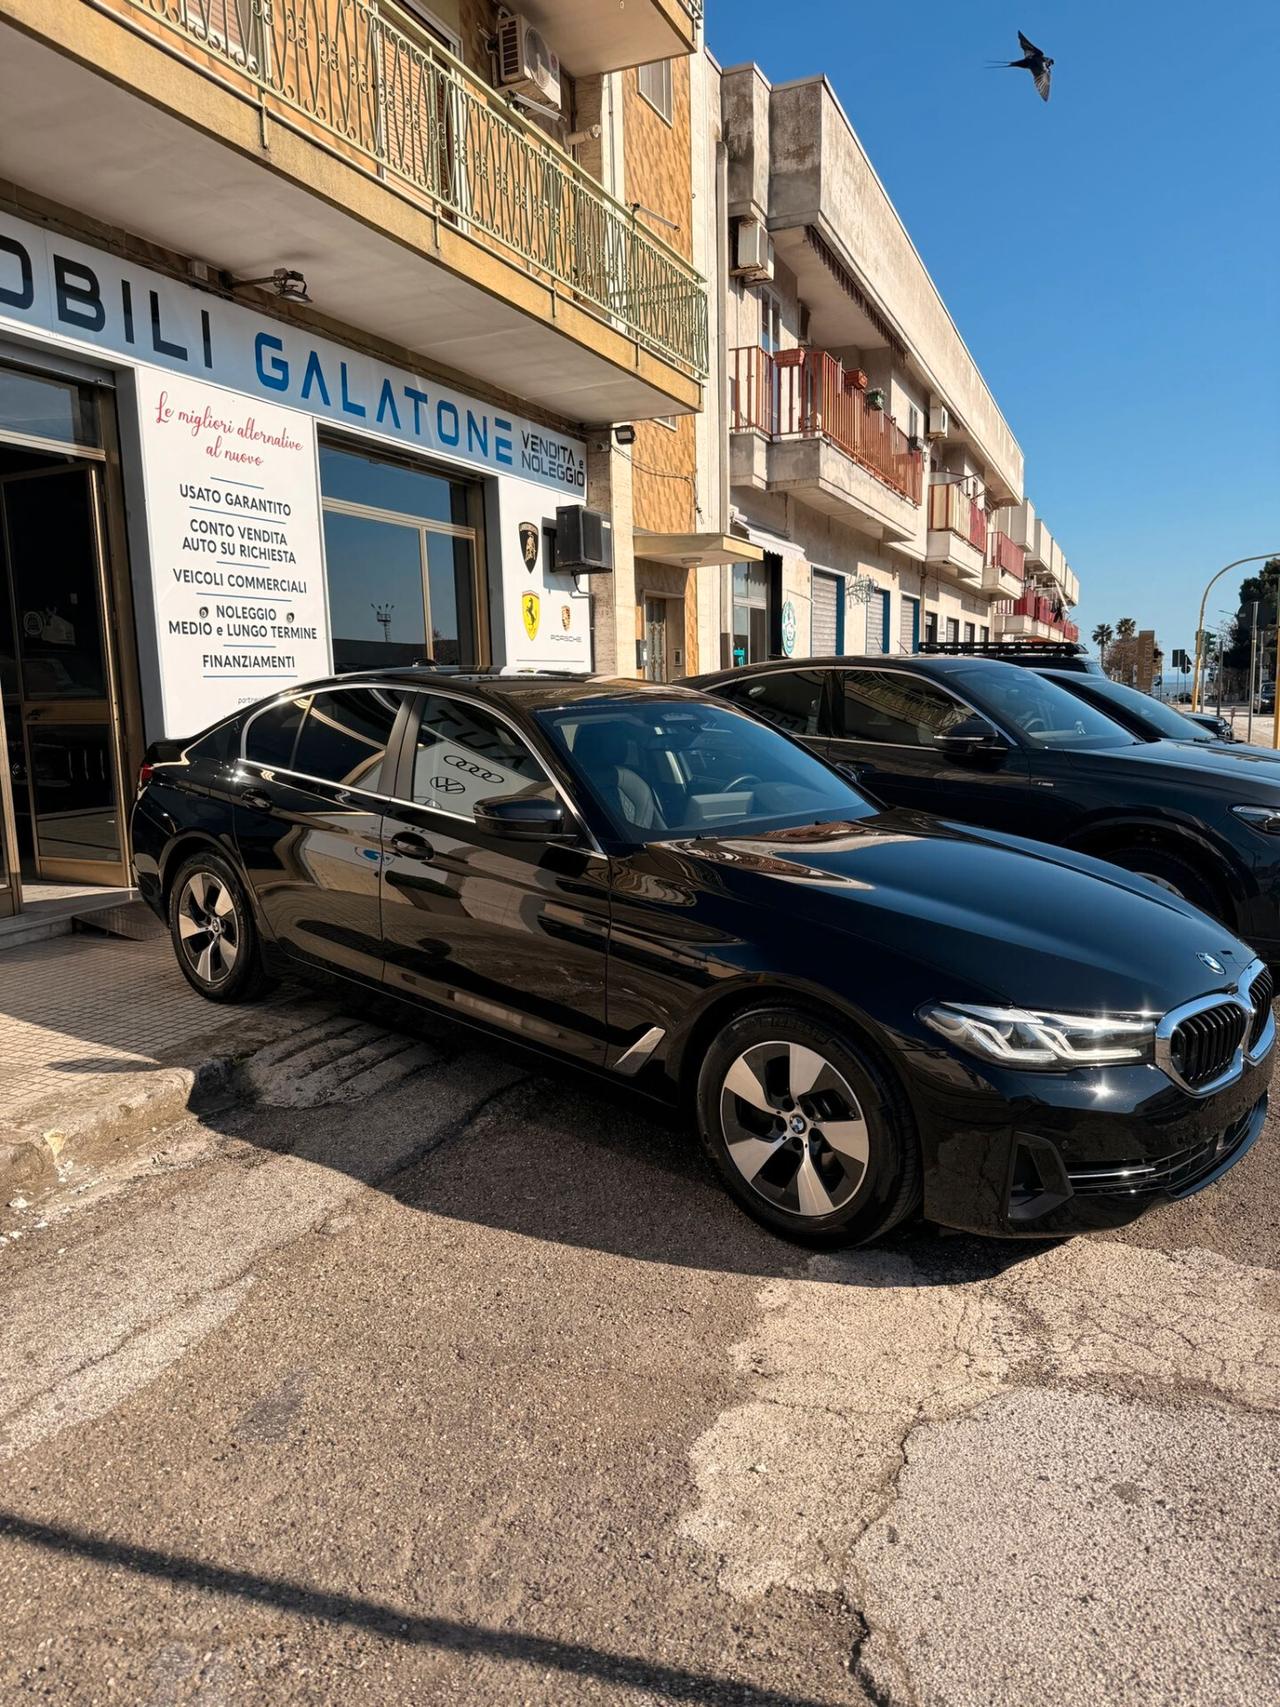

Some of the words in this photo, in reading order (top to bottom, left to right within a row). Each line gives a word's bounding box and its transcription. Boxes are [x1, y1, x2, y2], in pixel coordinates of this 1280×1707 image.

[254, 331, 513, 466] GALATONE
[154, 391, 175, 424] Le
[178, 405, 235, 436] migliori
[237, 416, 304, 451] alternative
[205, 435, 222, 458] al
[224, 448, 265, 466] nuovo
[521, 430, 575, 467] VENDITA
[578, 459, 584, 469] e
[521, 451, 585, 487] NOLEGGIO
[180, 483, 221, 504] USATO
[225, 492, 291, 516] GARANTITO
[190, 518, 235, 538] CONTO
[237, 526, 288, 546] VENDITA
[182, 537, 217, 554] AUTO
[220, 541, 236, 556] SU
[240, 546, 297, 564] RICHIESTA
[173, 568, 224, 586] VEICOLI
[227, 574, 307, 594] COMMERCIALI
[216, 605, 277, 621] NOLEGGIO
[168, 620, 213, 636] MEDIO
[216, 625, 223, 636] e
[227, 623, 268, 638] LUNGO
[270, 625, 318, 640] TERMINE
[202, 654, 295, 669] FINANZIAMENTI
